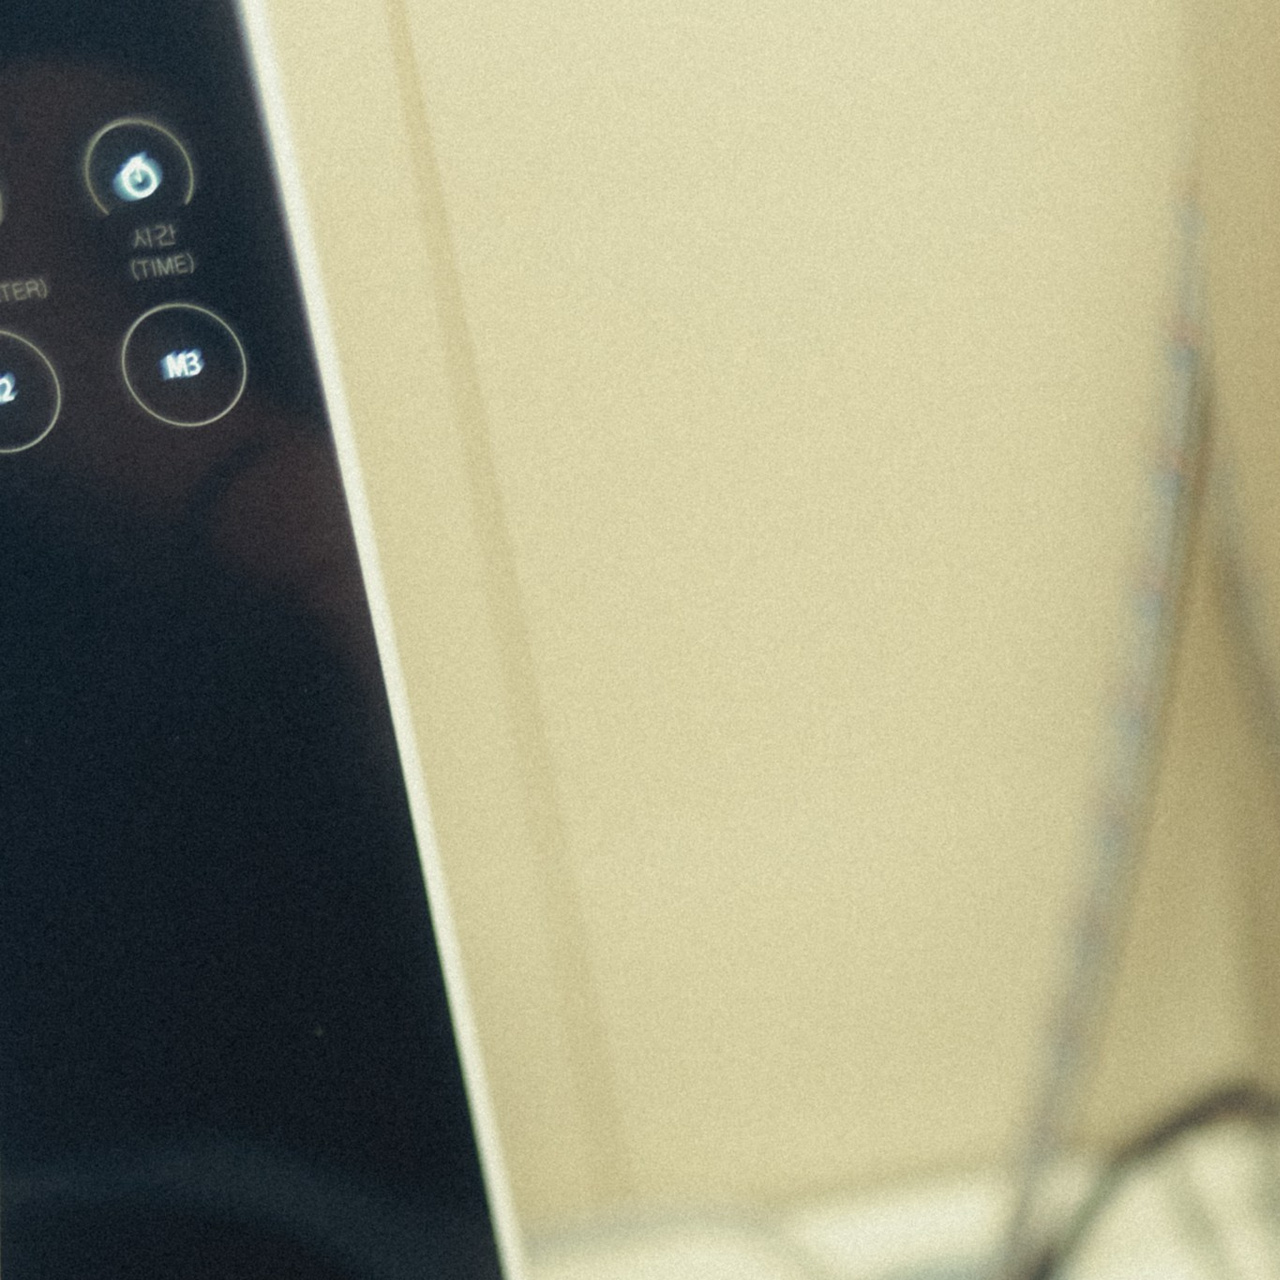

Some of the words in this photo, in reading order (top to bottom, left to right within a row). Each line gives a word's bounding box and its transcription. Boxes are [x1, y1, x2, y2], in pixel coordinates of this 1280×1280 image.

[133, 224, 177, 248] 시간
[131, 252, 195, 281] (TIME)
[163, 348, 203, 379] M3
